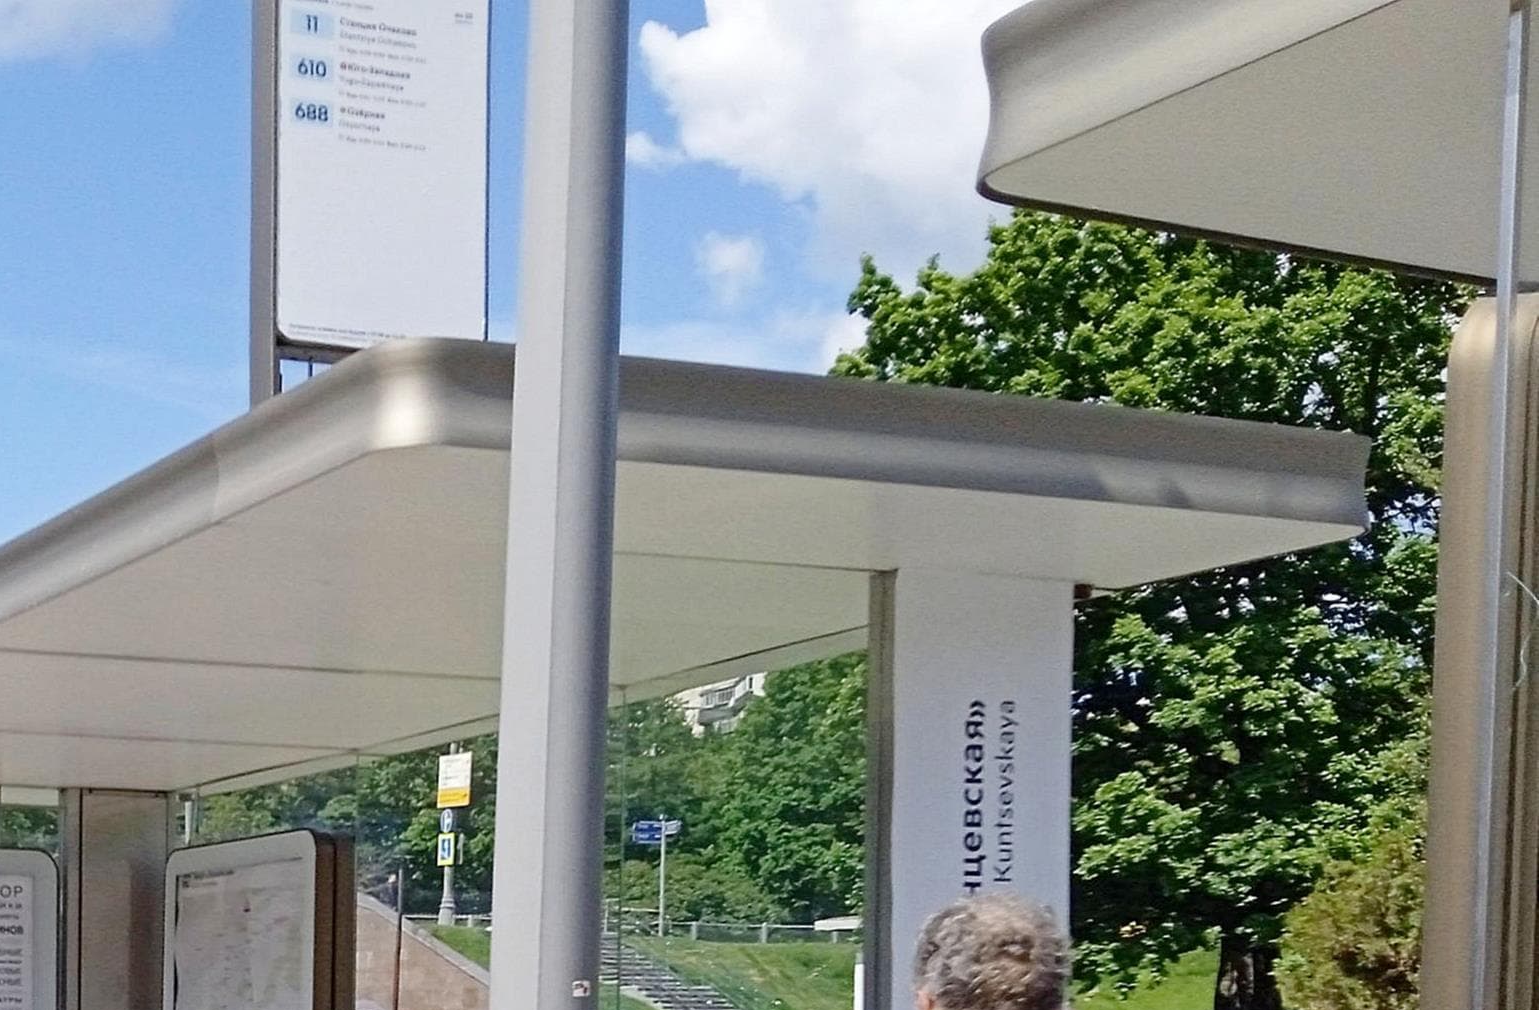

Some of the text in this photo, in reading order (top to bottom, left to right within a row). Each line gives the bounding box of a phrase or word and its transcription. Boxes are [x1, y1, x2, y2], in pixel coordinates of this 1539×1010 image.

[306, 15, 318, 33] 11
[297, 58, 327, 77] 610
[295, 103, 329, 122] 688
[993, 700, 1019, 883] Kuntsevskaya
